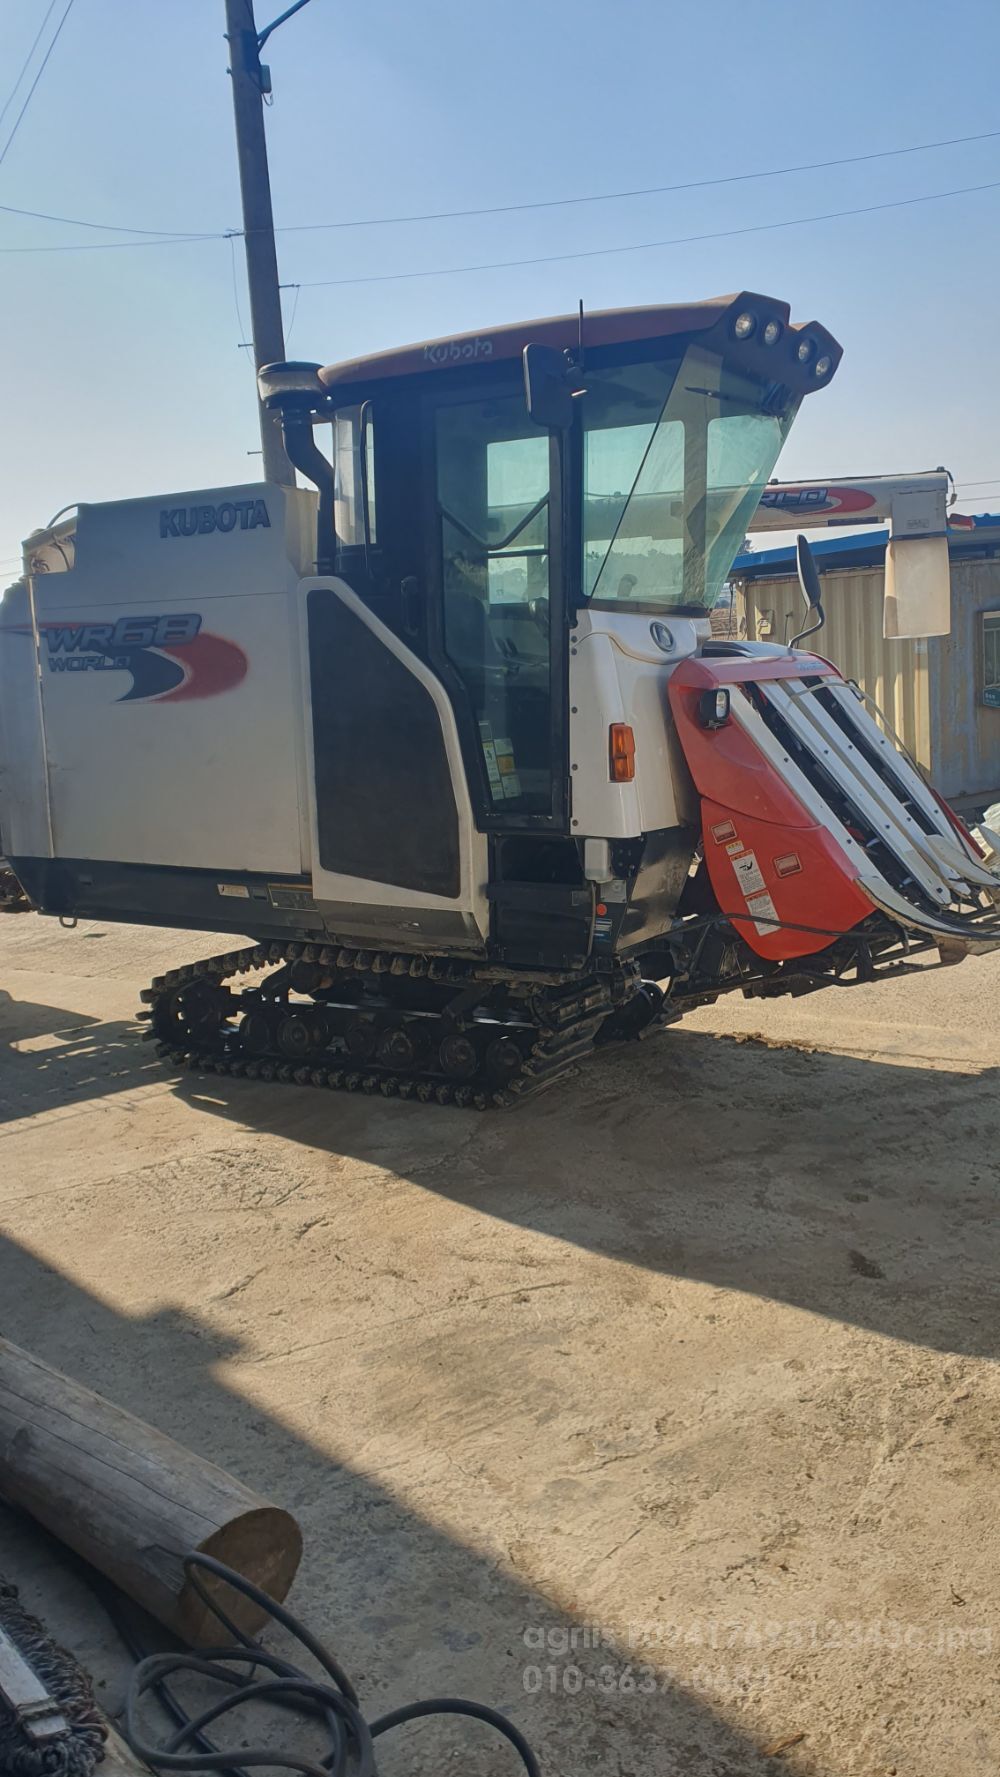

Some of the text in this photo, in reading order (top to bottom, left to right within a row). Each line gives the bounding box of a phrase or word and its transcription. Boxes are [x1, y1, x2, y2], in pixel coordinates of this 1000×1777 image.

[424, 337, 493, 364] Kubota
[160, 499, 272, 539] KUBOTA
[46, 613, 203, 654] WR68
[48, 655, 131, 672] WORLD
